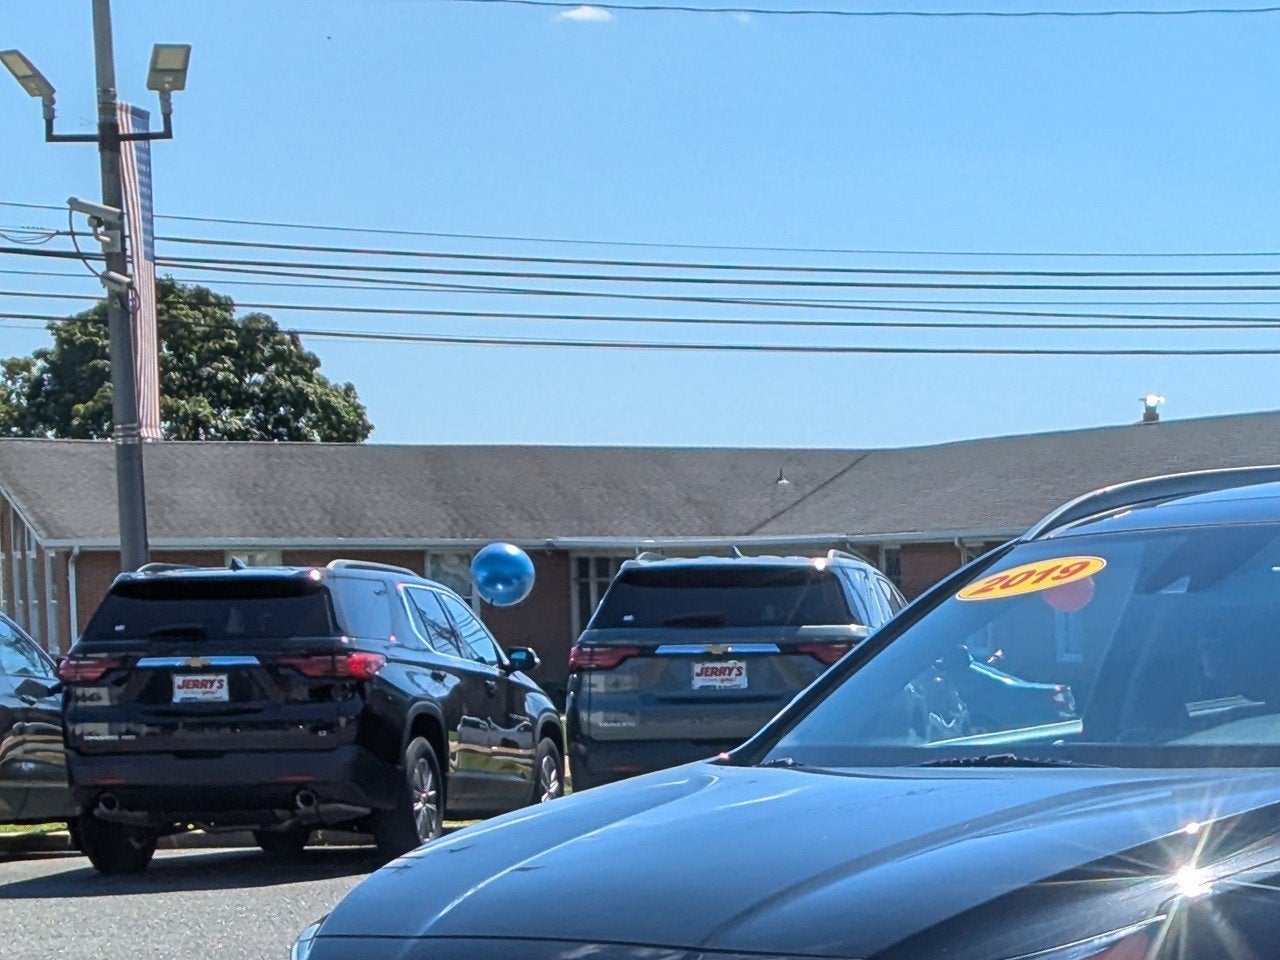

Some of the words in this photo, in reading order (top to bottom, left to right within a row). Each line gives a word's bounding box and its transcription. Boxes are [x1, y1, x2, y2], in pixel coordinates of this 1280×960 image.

[968, 560, 1091, 597] 2019
[695, 665, 744, 677] JERRY'S
[176, 679, 224, 689] JERRY'S
